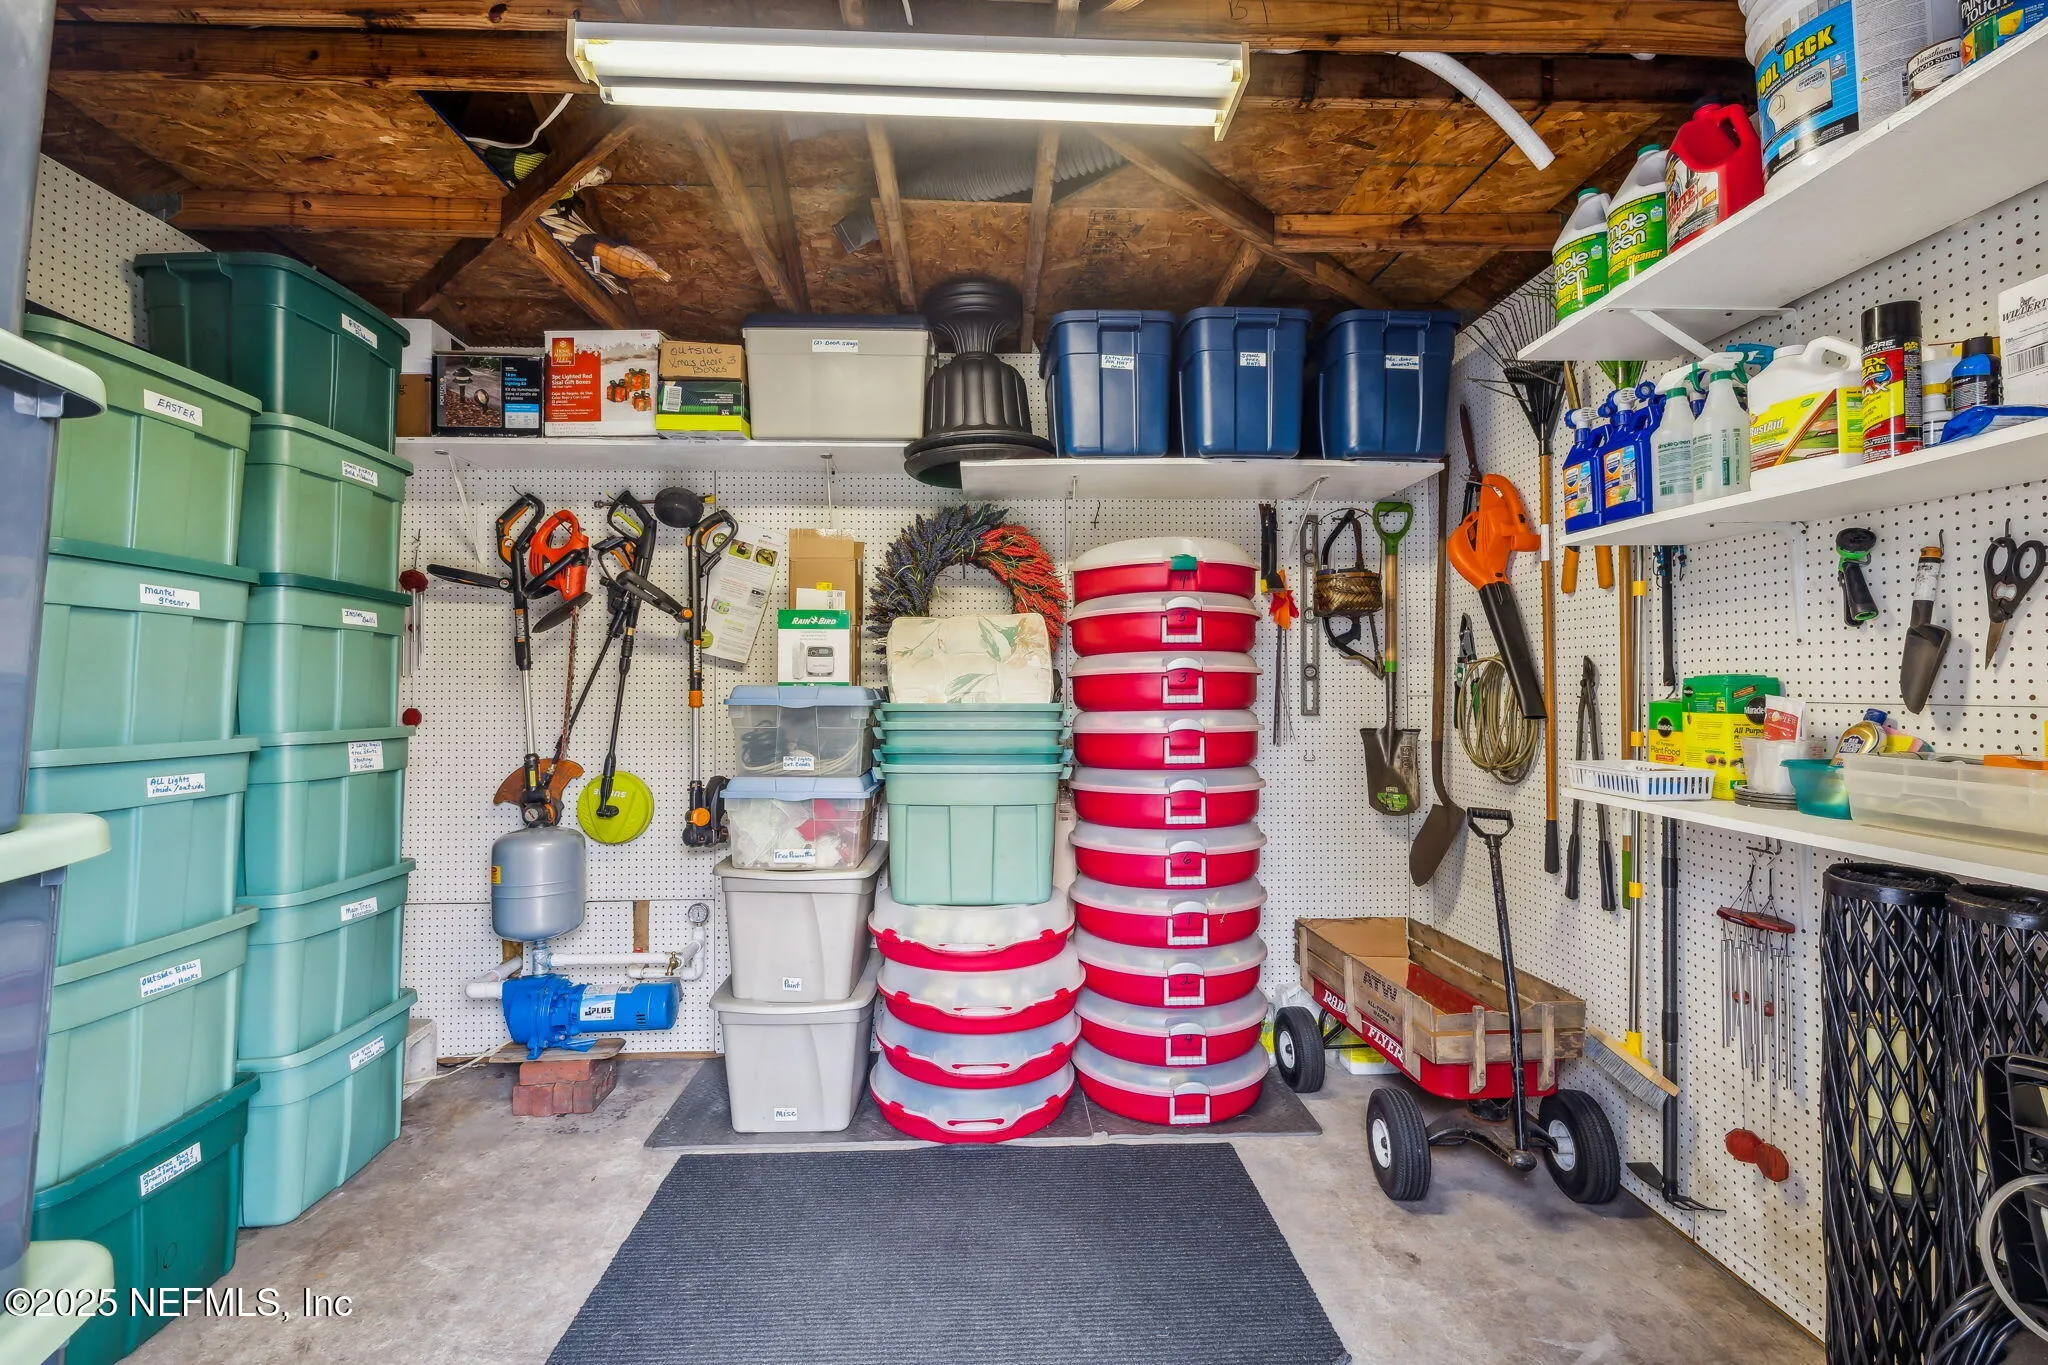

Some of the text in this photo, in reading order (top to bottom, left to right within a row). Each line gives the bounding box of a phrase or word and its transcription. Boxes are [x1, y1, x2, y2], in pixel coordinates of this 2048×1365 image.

[1783, 25, 1835, 71] DECK
[1912, 52, 1959, 76] WOOD STAIN
[1608, 211, 1648, 242] mple
[1626, 249, 1663, 266] Cleaner
[157, 398, 197, 421] EASTER
[791, 616, 837, 625] RAIN BIRD
[1178, 672, 1188, 683] 3
[1744, 727, 1764, 735] Purpo
[1664, 747, 1680, 756] Food
[1182, 853, 1192, 864] 6
[1362, 971, 1398, 1002] ATW
[1367, 1000, 1396, 1021] ALL-TERRAIN
[1373, 1010, 1389, 1024] WAGON
[1367, 1026, 1404, 1063] FLYER
